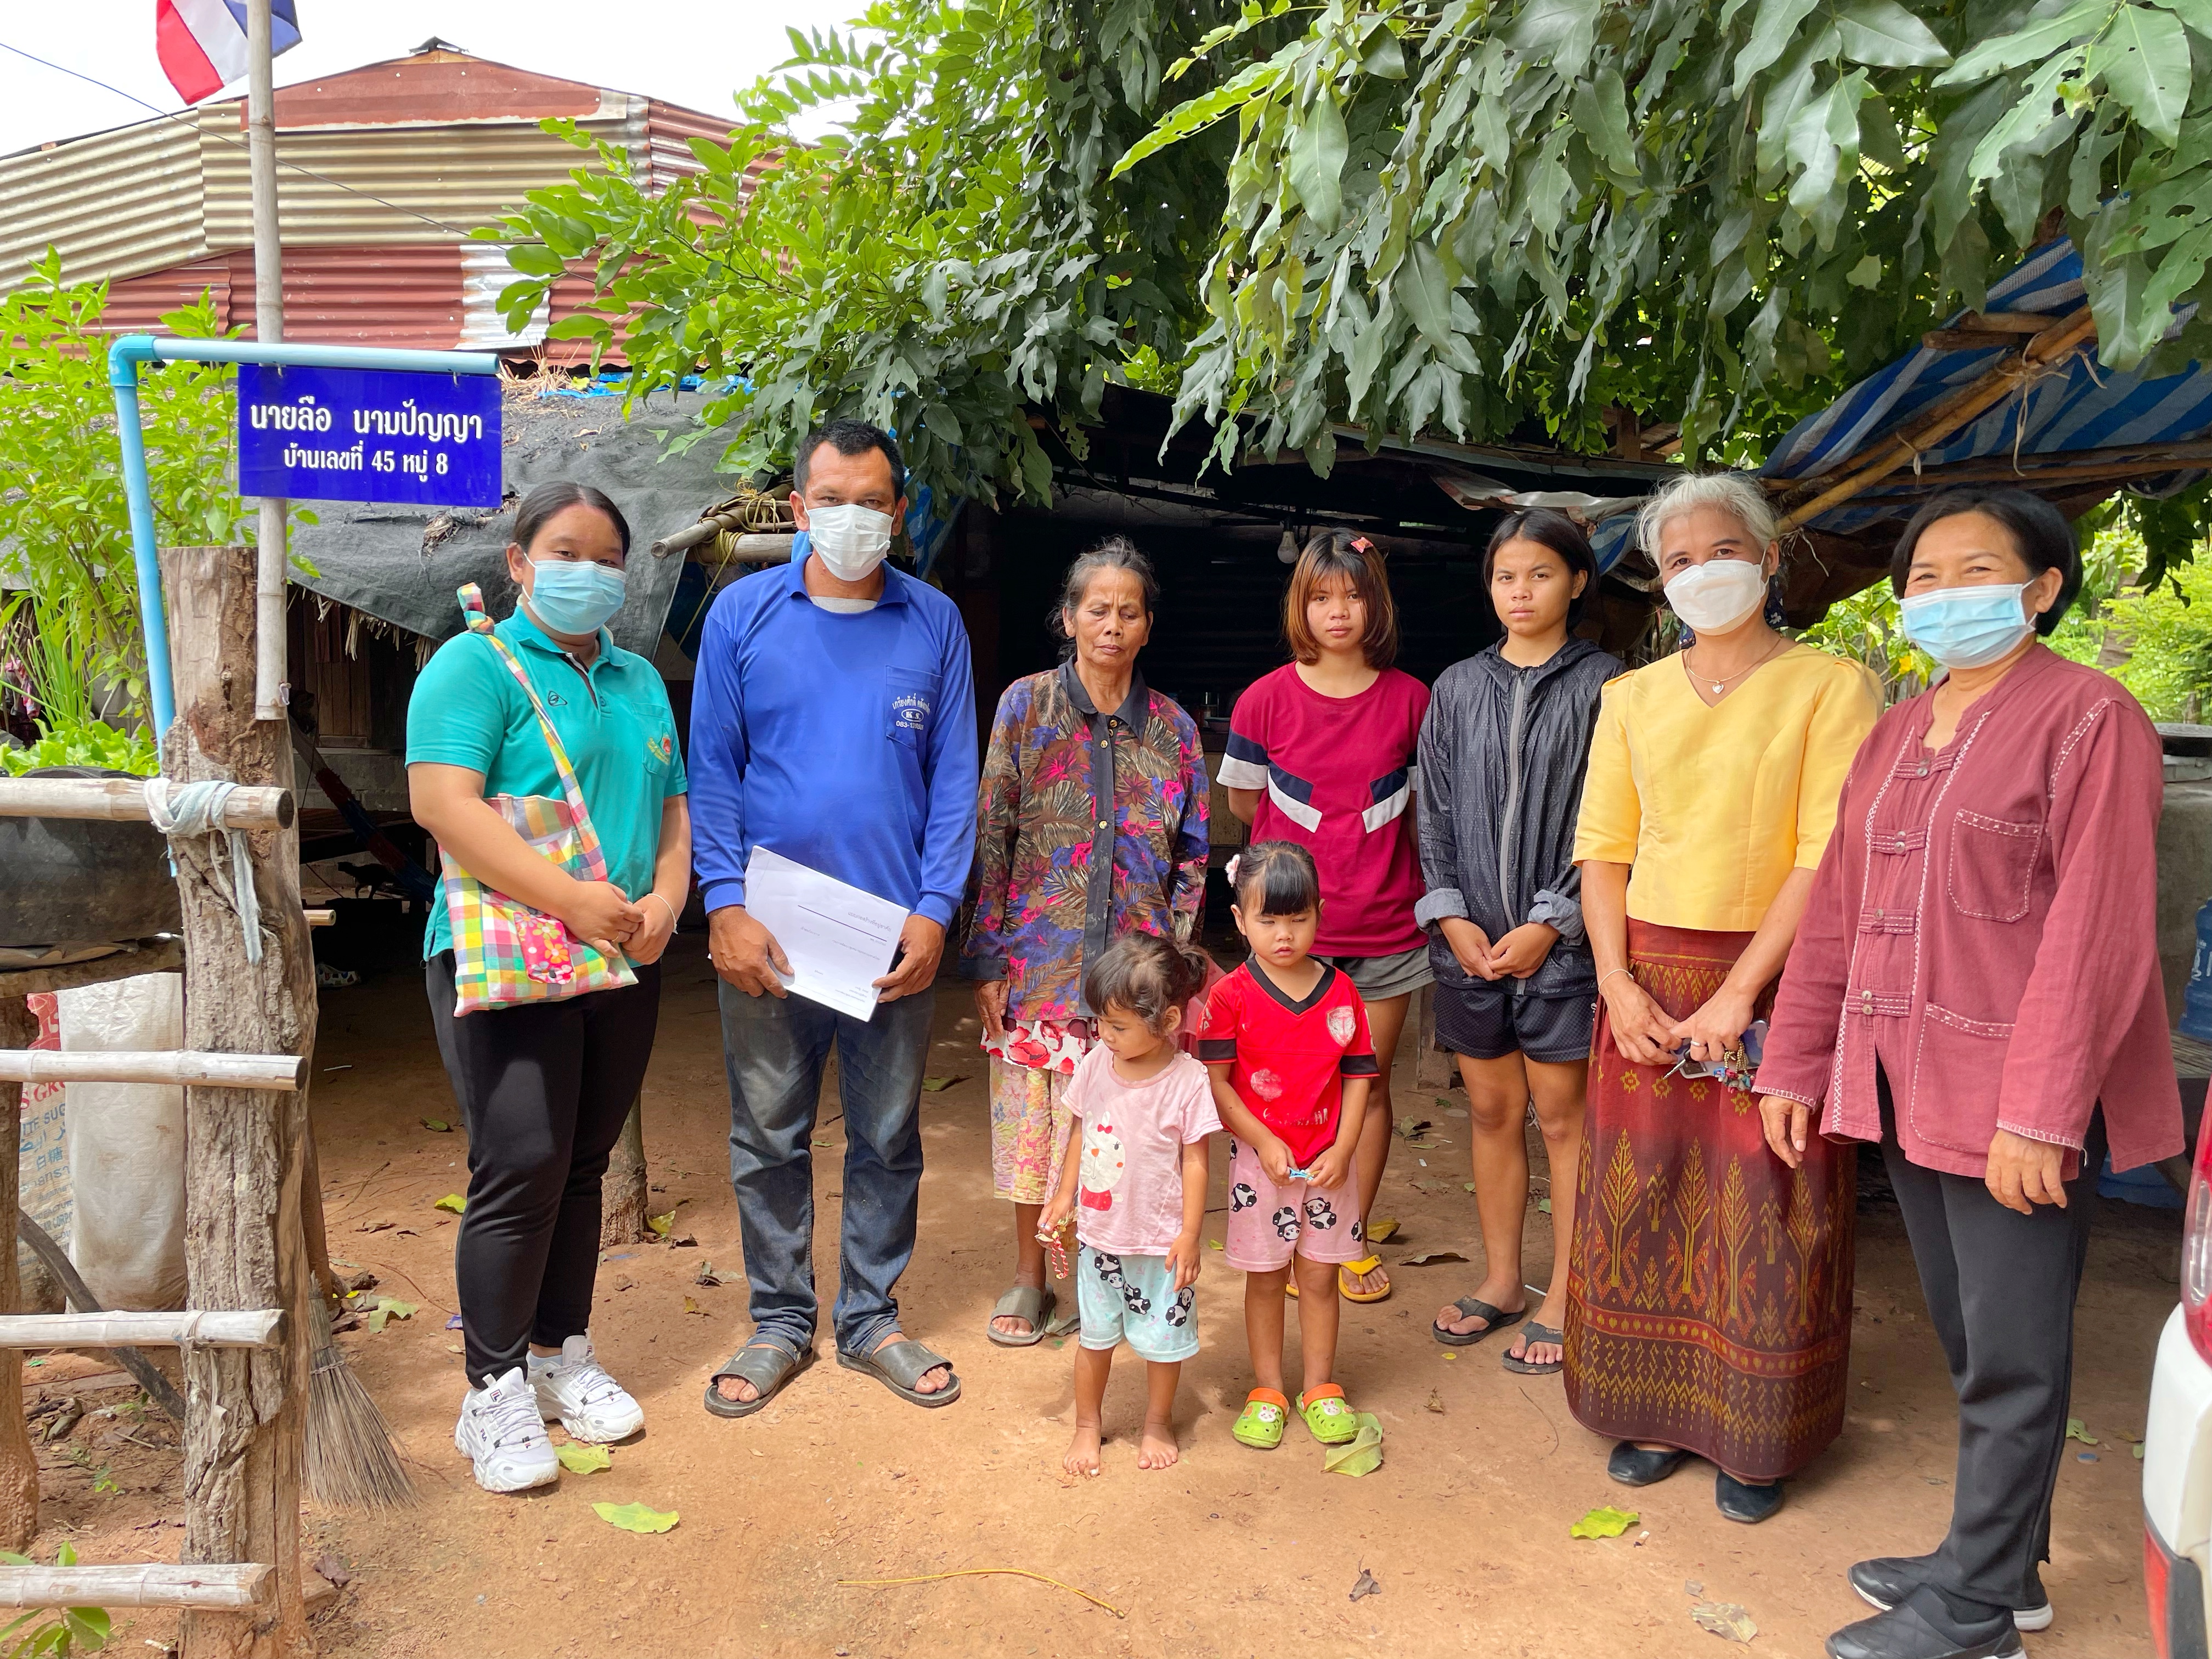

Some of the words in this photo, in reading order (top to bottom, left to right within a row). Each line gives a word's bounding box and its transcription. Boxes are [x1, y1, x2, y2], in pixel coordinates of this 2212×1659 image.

[251, 395, 332, 432] นายลือ
[353, 398, 483, 443] นามปัญญา
[284, 440, 363, 471] บ้านเลขที่
[371, 450, 395, 472] 45
[403, 449, 428, 483] หมู่
[435, 453, 449, 475] 8
[22, 1116, 39, 1136] ITE
[44, 1102, 65, 1125] SUG
